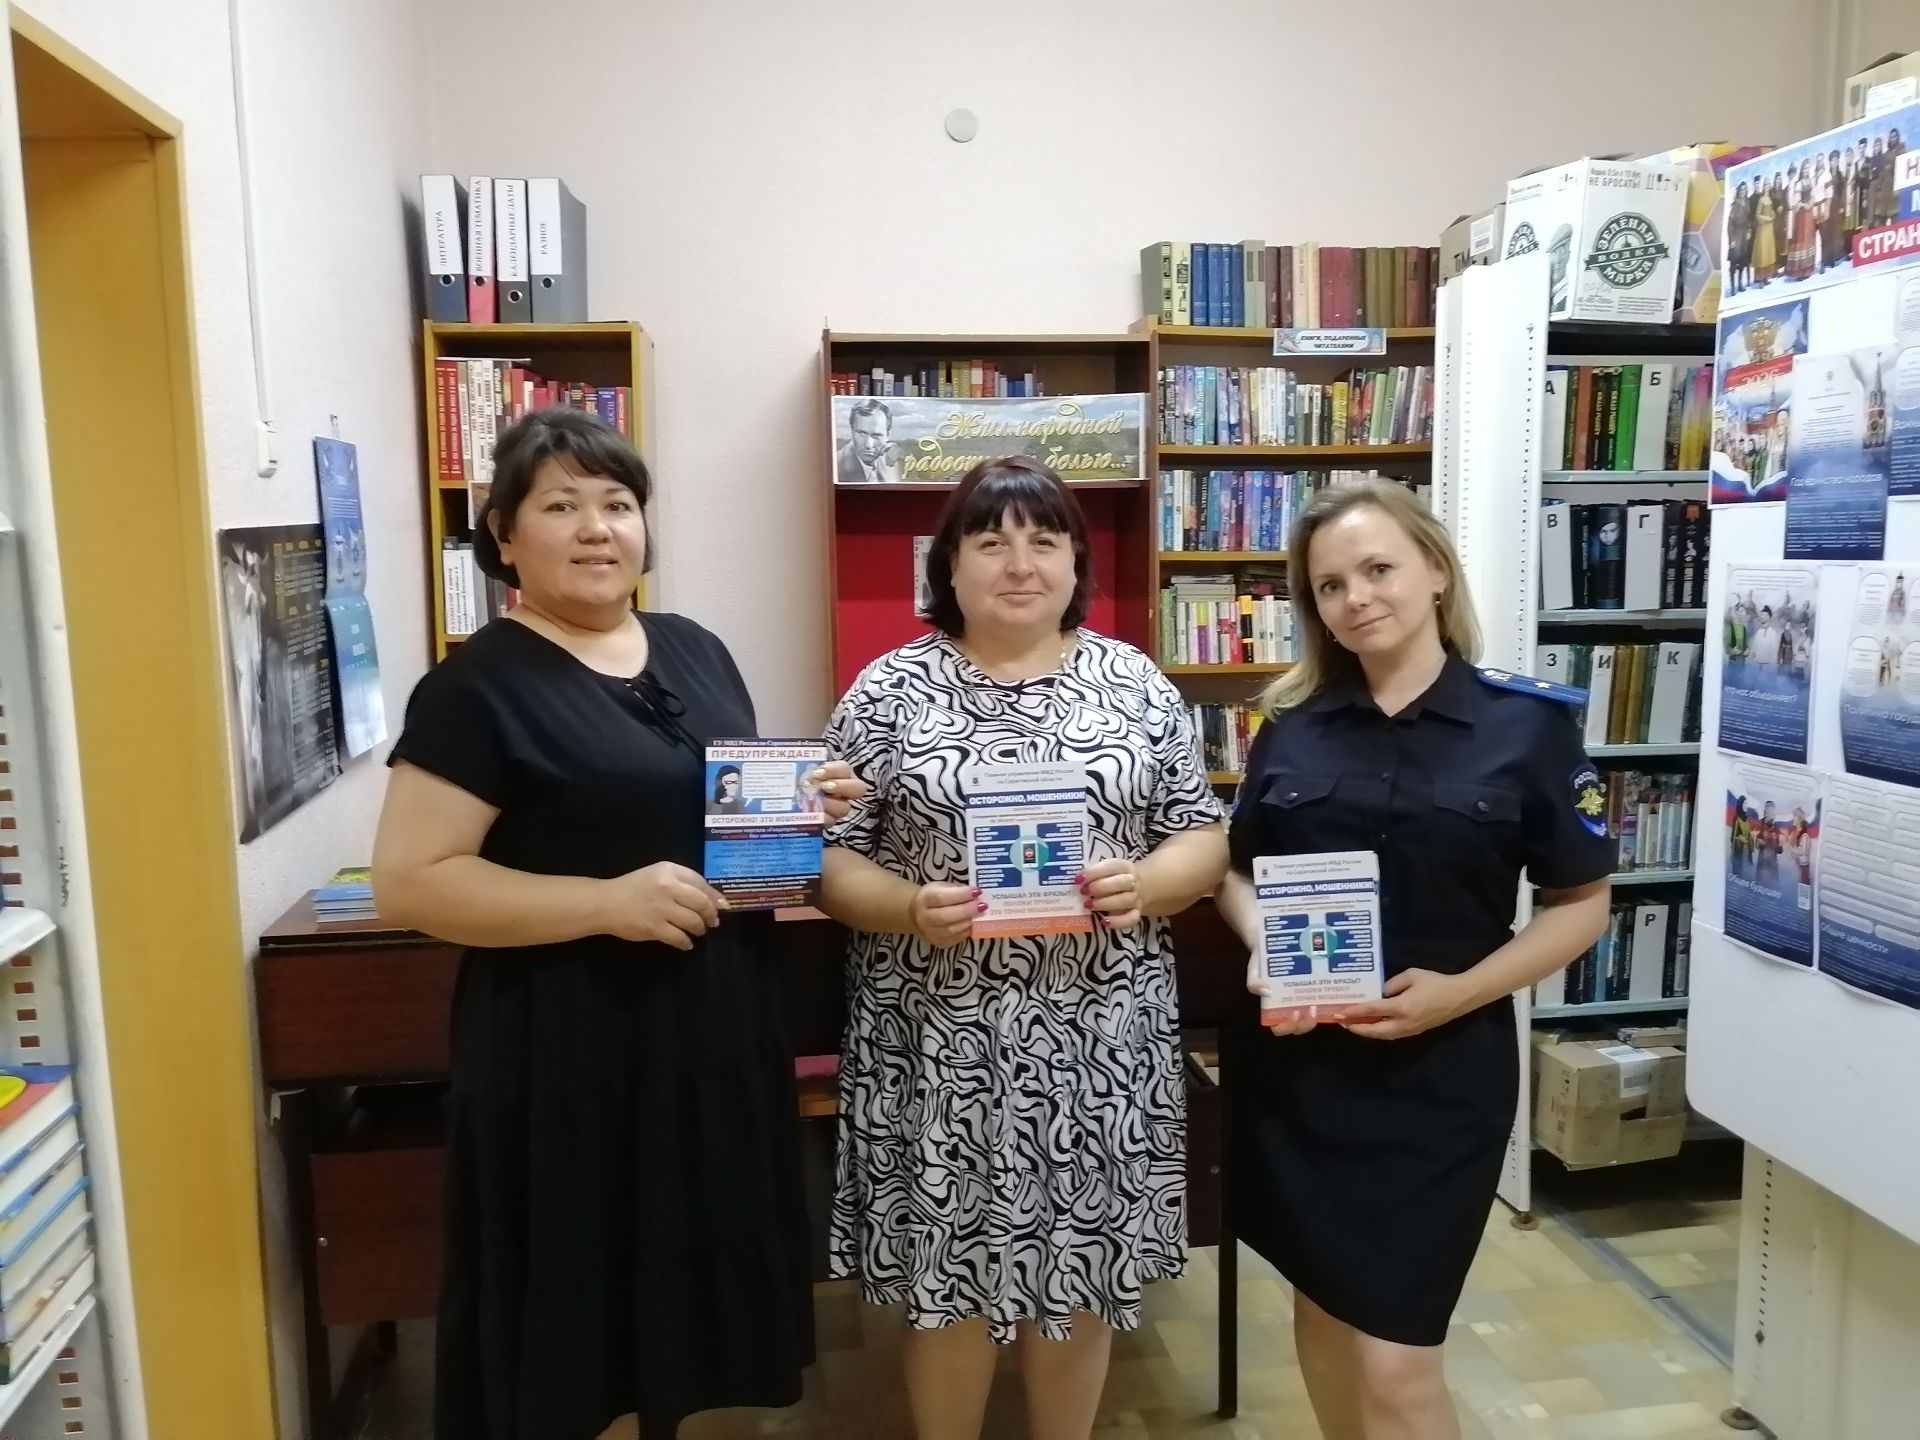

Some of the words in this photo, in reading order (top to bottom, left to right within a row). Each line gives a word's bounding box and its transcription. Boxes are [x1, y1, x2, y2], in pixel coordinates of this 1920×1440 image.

[474, 180, 482, 229] ТЕМАТИКА
[507, 184, 515, 210] ДАТЫ
[435, 210, 447, 267] ЛИТЕРАТУРА
[540, 221, 549, 255] РАЗНОЕ
[1598, 216, 1655, 250] ЗЕЛЁНАЯ
[475, 231, 483, 272] ВОЕННАЯ
[507, 211, 519, 277] КАЛЕНДАРНЫЕ
[1598, 246, 1656, 263] ВОДКА
[1603, 261, 1653, 284] МАРКА
[1650, 371, 1661, 386] Б
[1544, 380, 1556, 395] А
[1016, 401, 1125, 444] народной
[1547, 513, 1558, 529] В
[1638, 513, 1650, 529] Г
[1546, 653, 1557, 667] З
[1597, 654, 1611, 669] И
[1667, 650, 1680, 665] К
[969, 794, 1027, 806] ОСТОРОЖНО,
[1027, 791, 1085, 802] МОШЕННИКИ!
[1259, 885, 1315, 896] ОСТОРОЖНО,
[1645, 913, 1656, 927] Р
